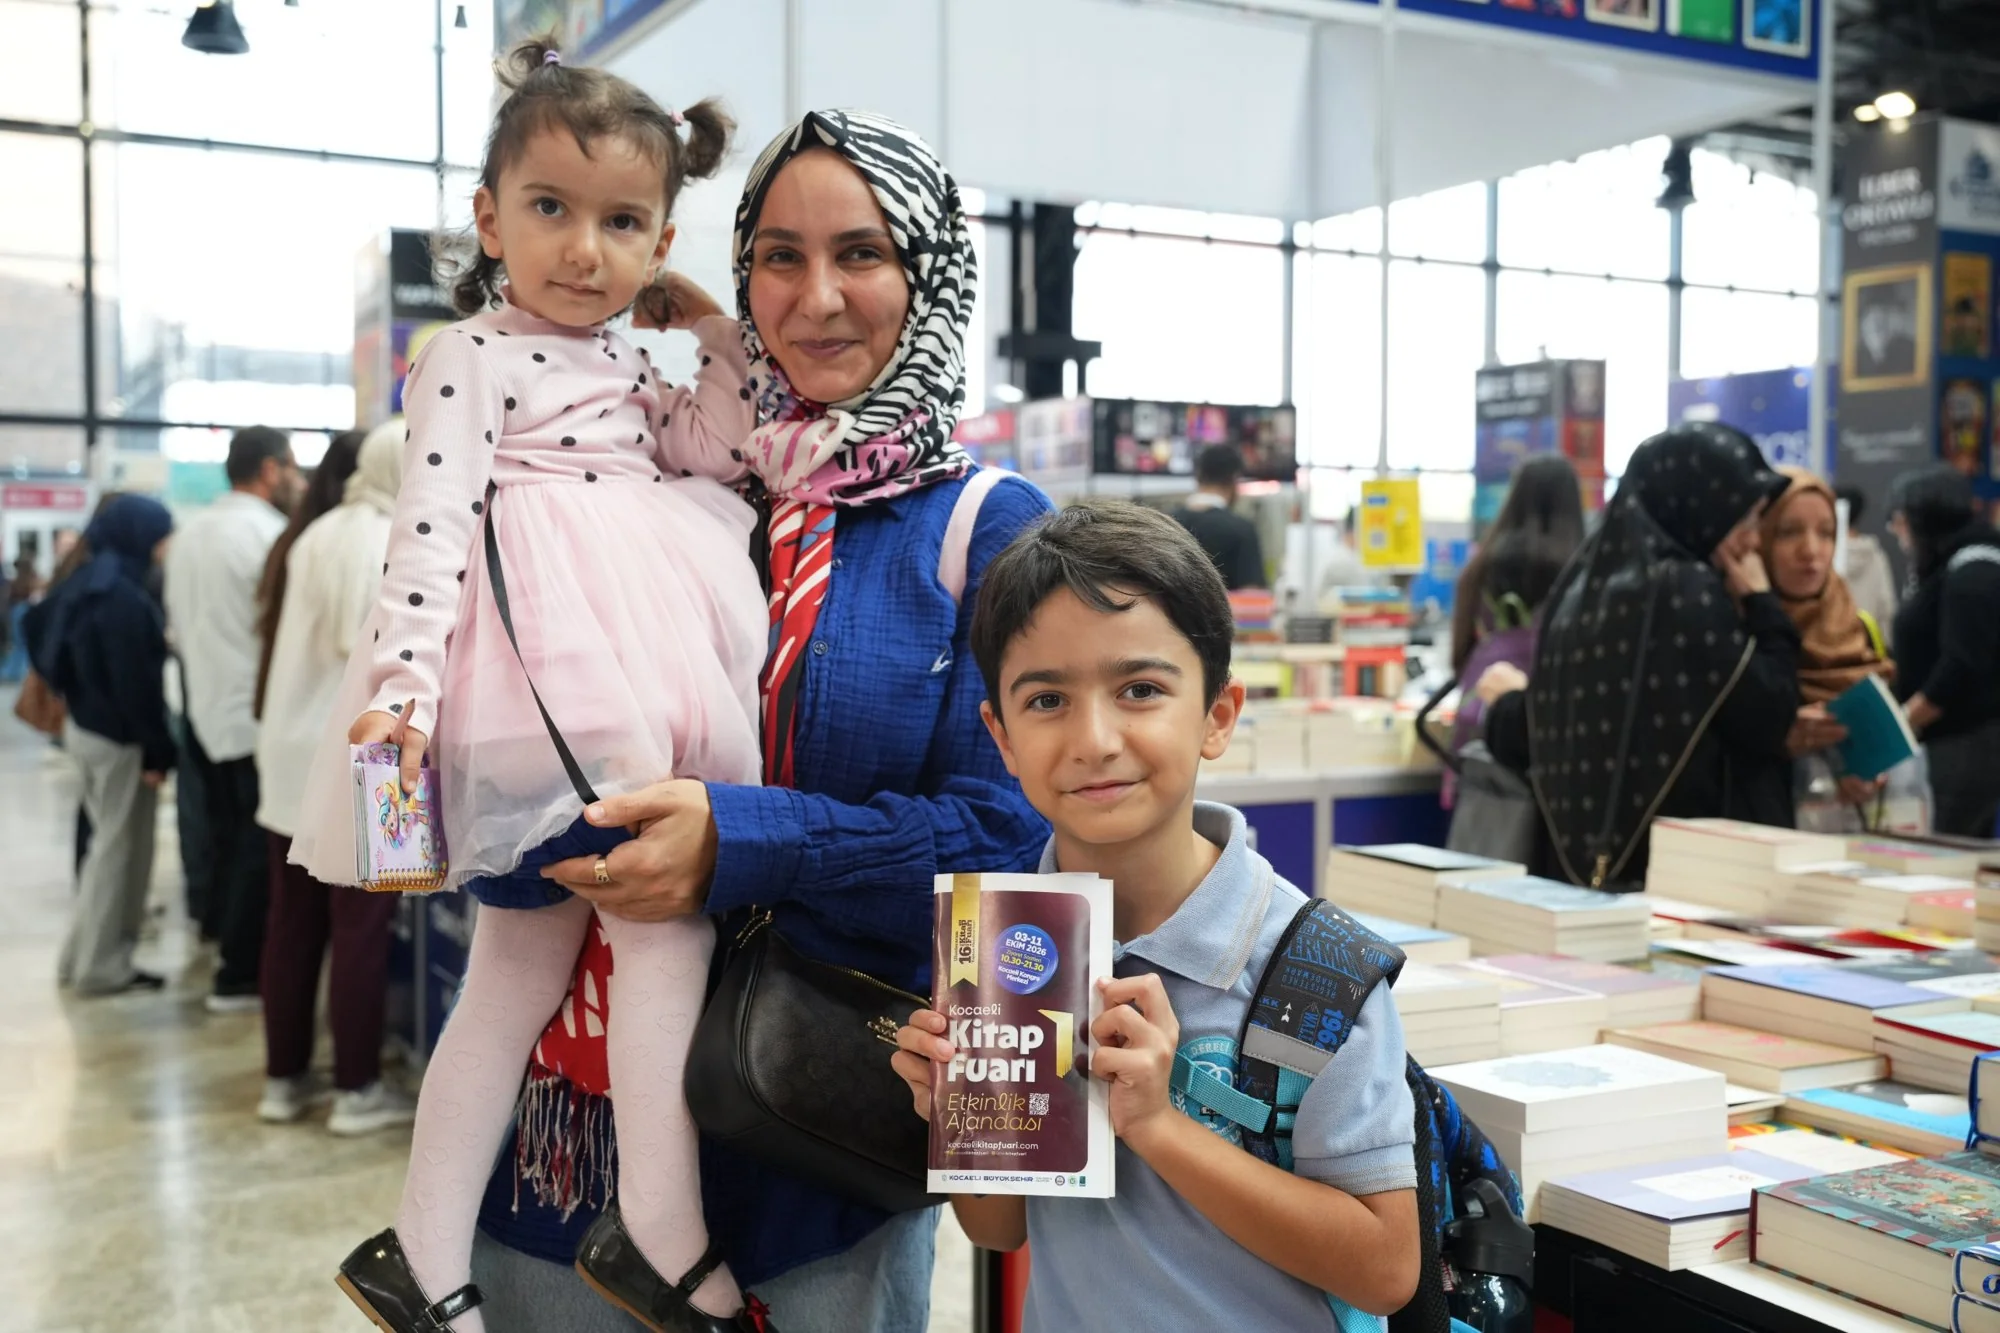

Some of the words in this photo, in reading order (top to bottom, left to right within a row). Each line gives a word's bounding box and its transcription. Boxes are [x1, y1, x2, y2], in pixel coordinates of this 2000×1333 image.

[958, 919, 968, 944] Kitap
[1014, 931, 1042, 947] 03-11
[1001, 953, 1044, 972] 10.30-21.30
[949, 1003, 1001, 1016] Kocaeli
[949, 1018, 1044, 1055] Kitap
[947, 1053, 1036, 1083] Fuarı
[947, 1092, 1026, 1112] Etkinlik
[946, 1112, 1042, 1134] Ajandası
